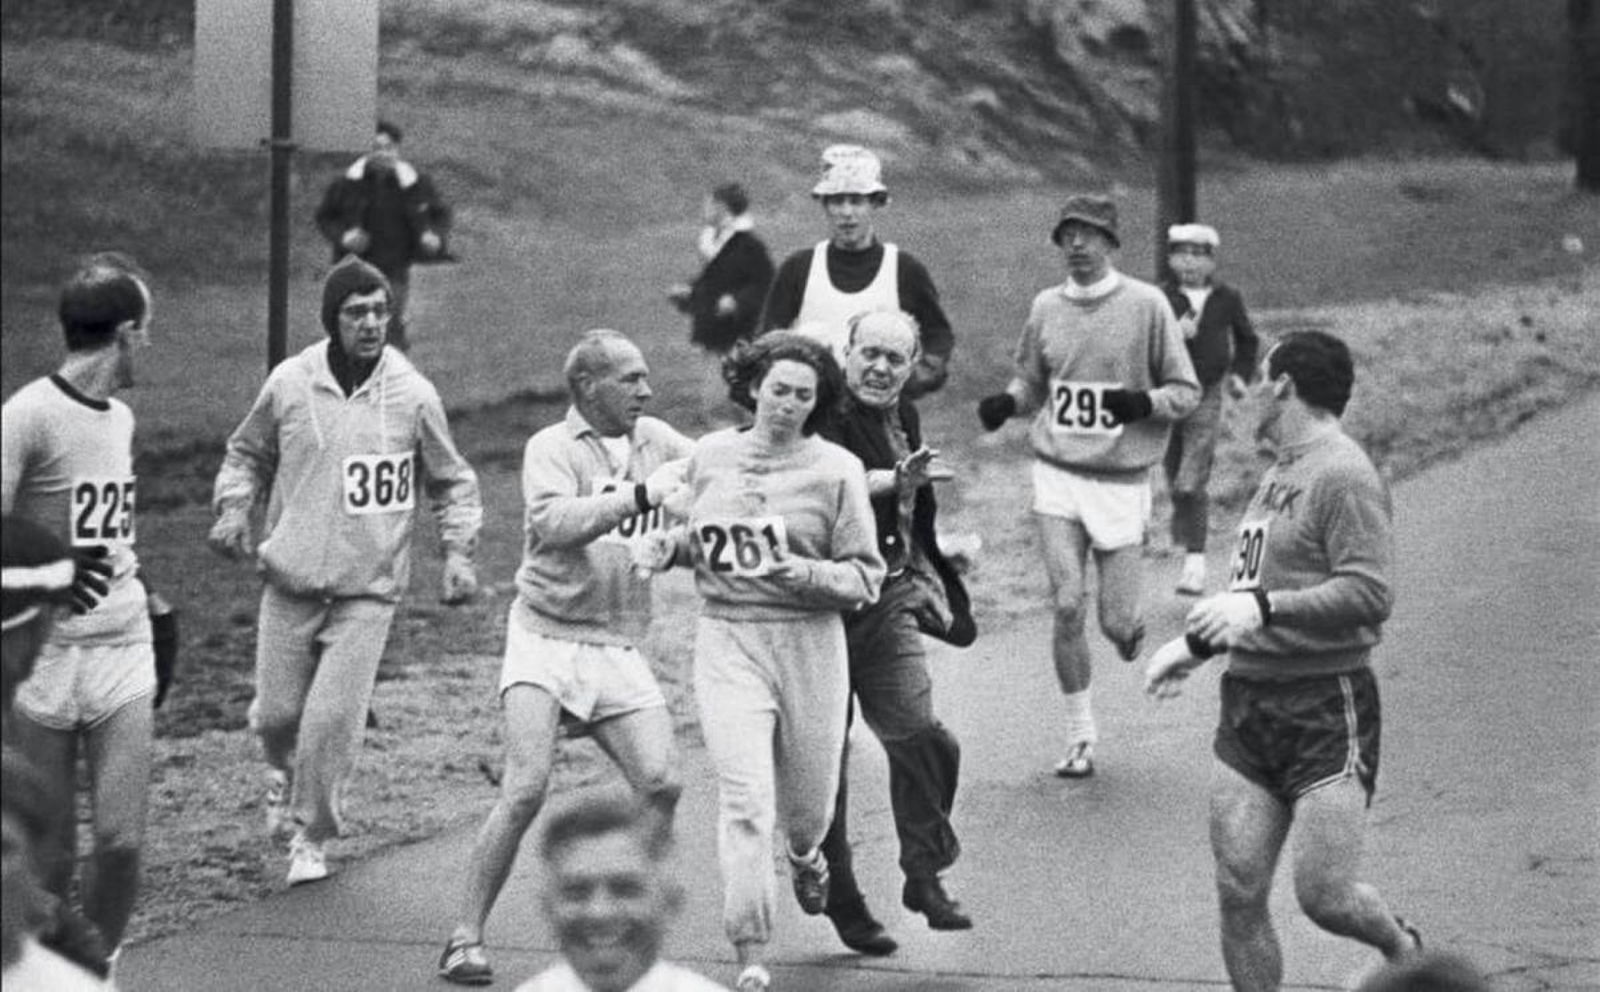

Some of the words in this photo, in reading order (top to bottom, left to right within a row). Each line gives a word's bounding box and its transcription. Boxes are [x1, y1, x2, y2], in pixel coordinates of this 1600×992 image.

[348, 458, 410, 508] 368
[76, 482, 134, 539] 225
[701, 524, 783, 572] 261
